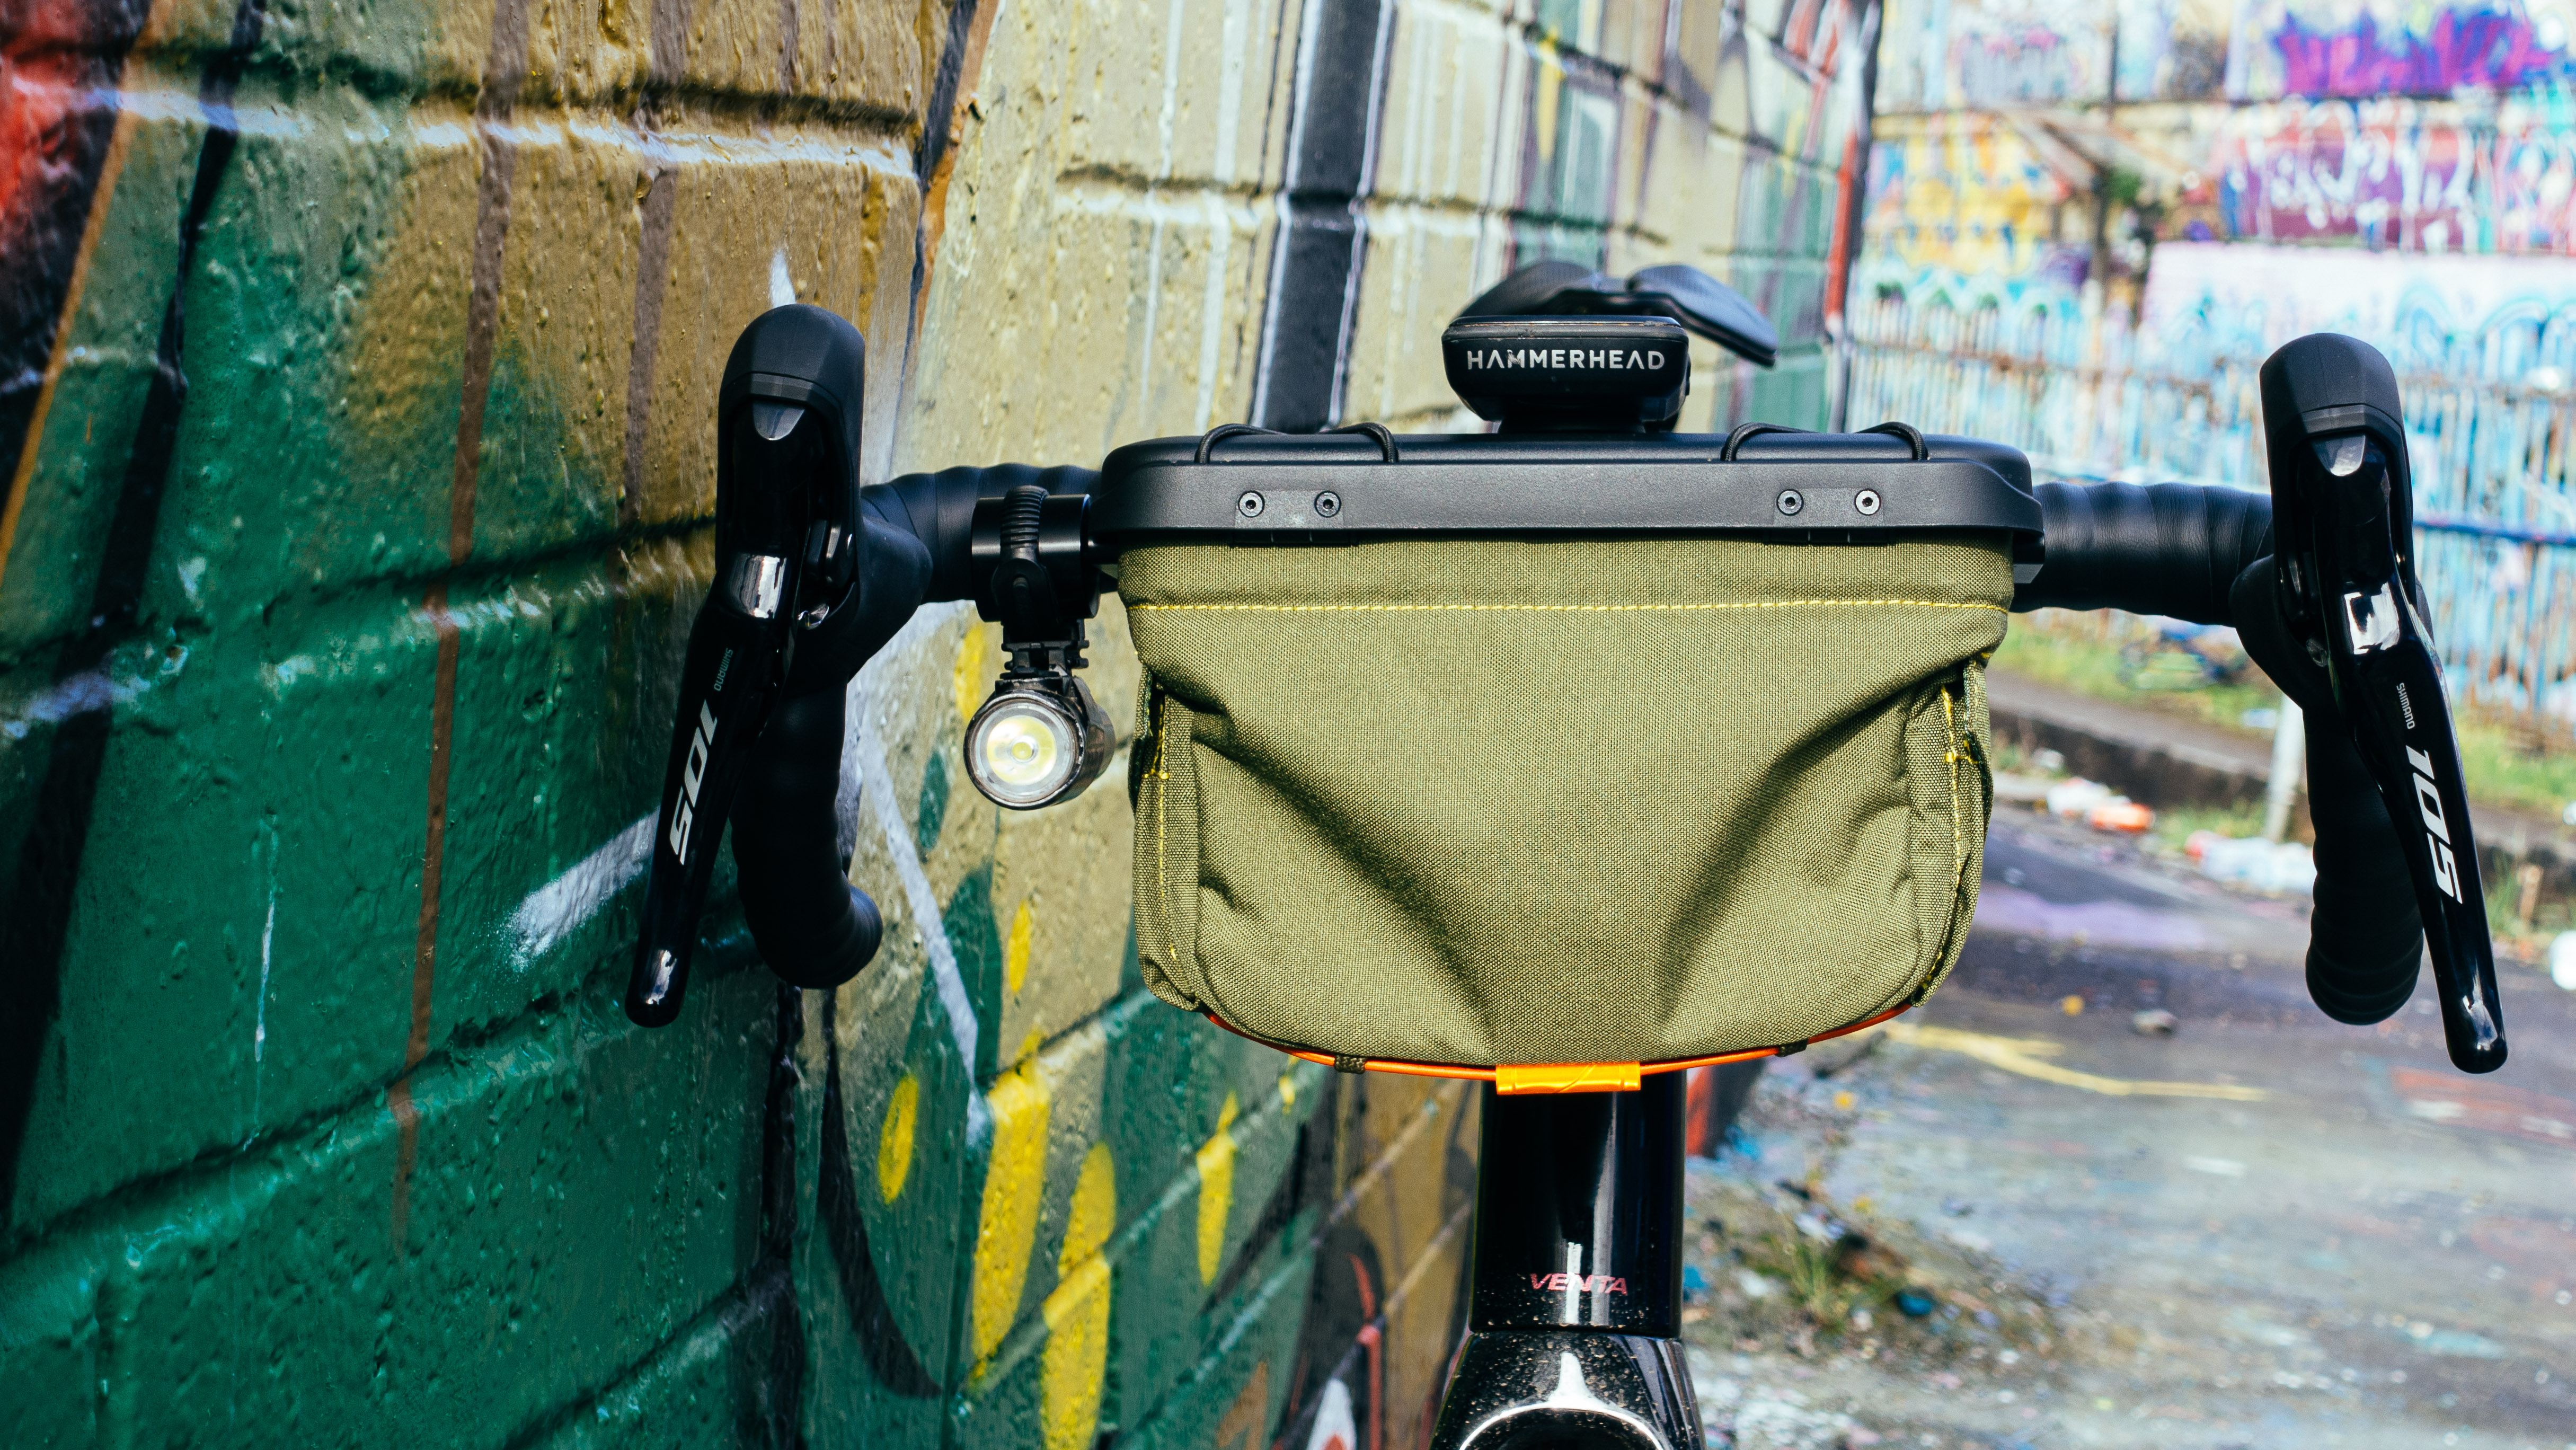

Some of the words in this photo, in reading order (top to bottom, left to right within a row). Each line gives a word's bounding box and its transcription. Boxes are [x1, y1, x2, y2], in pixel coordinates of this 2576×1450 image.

[1467, 349, 1665, 370] HAMMERHEAD
[713, 647, 733, 692] SHIMANO
[2396, 682, 2416, 730] SHIMANO
[669, 699, 718, 866] 105
[2405, 744, 2463, 904] 105
[1530, 1272, 1628, 1295] VENTA
